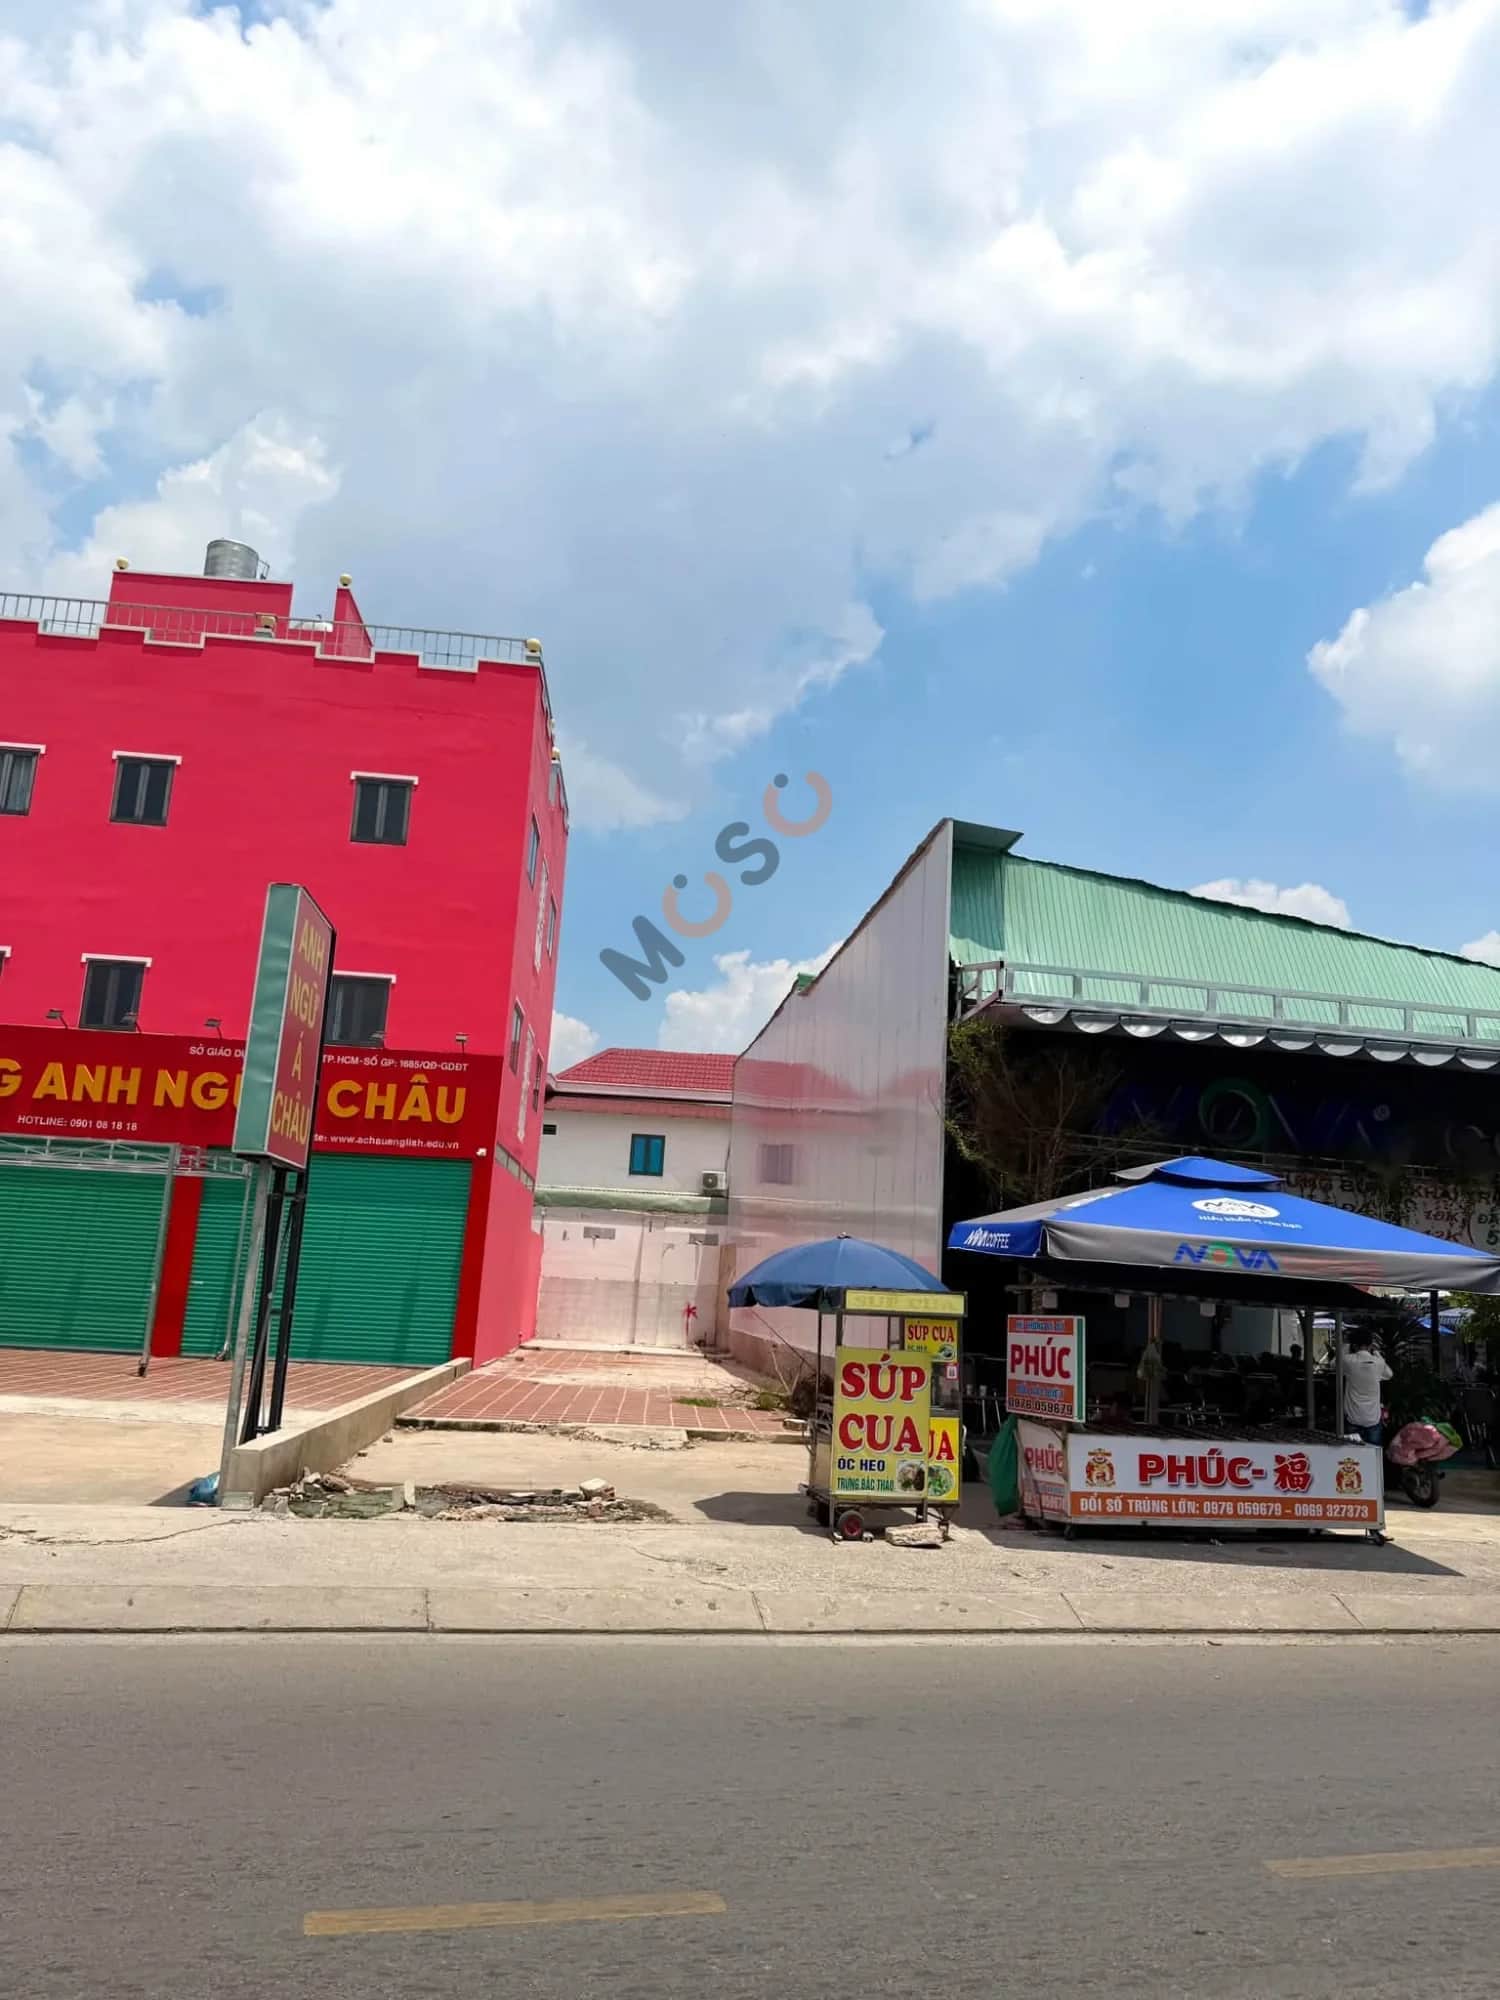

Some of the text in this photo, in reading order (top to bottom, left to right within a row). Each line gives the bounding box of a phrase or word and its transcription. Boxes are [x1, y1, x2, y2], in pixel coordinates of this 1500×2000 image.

[300, 919, 326, 975] ANH
[207, 1046, 232, 1057] GIÁO
[291, 1031, 305, 1081] Á
[32, 1061, 142, 1105] ANH
[326, 1073, 467, 1124] CHÂU
[17, 1114, 68, 1127] HOTLINE:
[70, 1118, 94, 1129] 0901
[271, 1090, 311, 1145] CHÂU
[1173, 1241, 1279, 1272] NOVA
[907, 1320, 955, 1343] SÚP CUA
[840, 1353, 927, 1403] SÚP
[1010, 1336, 1072, 1379] PHÚC
[838, 1412, 925, 1455] CUA
[859, 1458, 886, 1473] HEO
[1080, 1492, 1102, 1512] ĐỔI
[1106, 1494, 1124, 1513] SỐ
